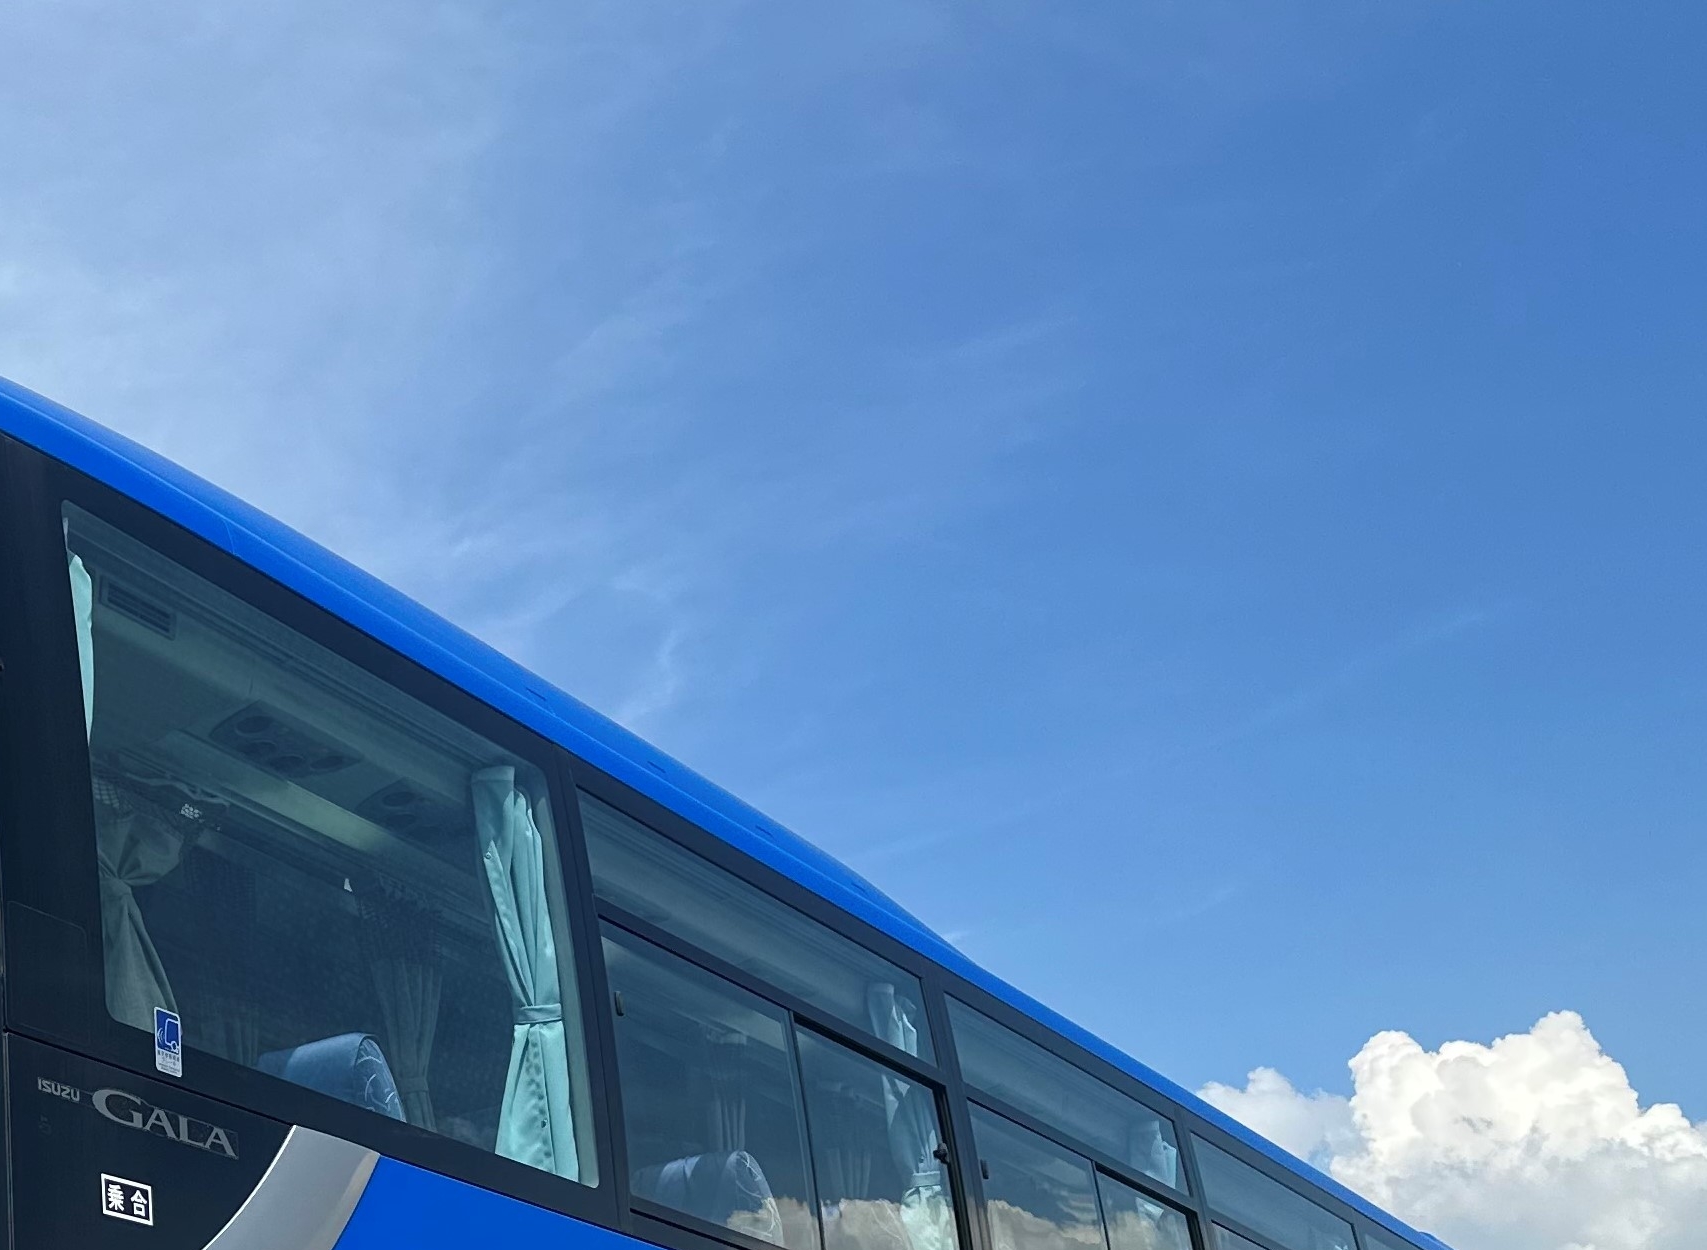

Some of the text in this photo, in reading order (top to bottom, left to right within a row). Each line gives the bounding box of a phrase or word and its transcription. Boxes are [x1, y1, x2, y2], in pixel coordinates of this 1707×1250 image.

[38, 1077, 238, 1160] ISUZU GALA
[107, 1183, 148, 1217] 乗合
